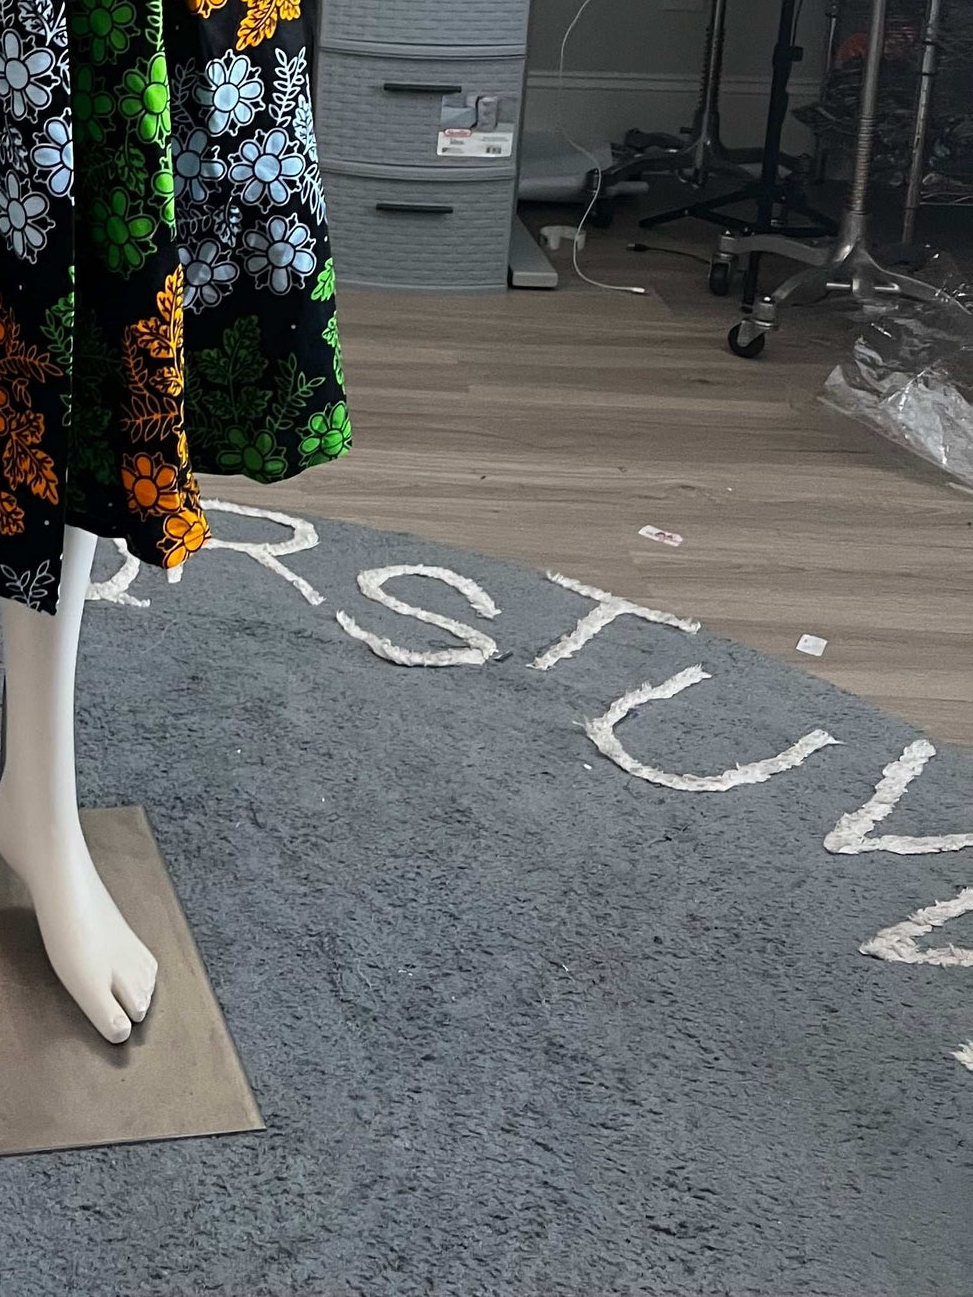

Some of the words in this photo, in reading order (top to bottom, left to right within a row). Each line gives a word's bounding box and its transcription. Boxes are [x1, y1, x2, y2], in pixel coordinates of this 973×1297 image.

[336, 563, 502, 666] S
[527, 569, 702, 671] T
[582, 664, 839, 792] U
